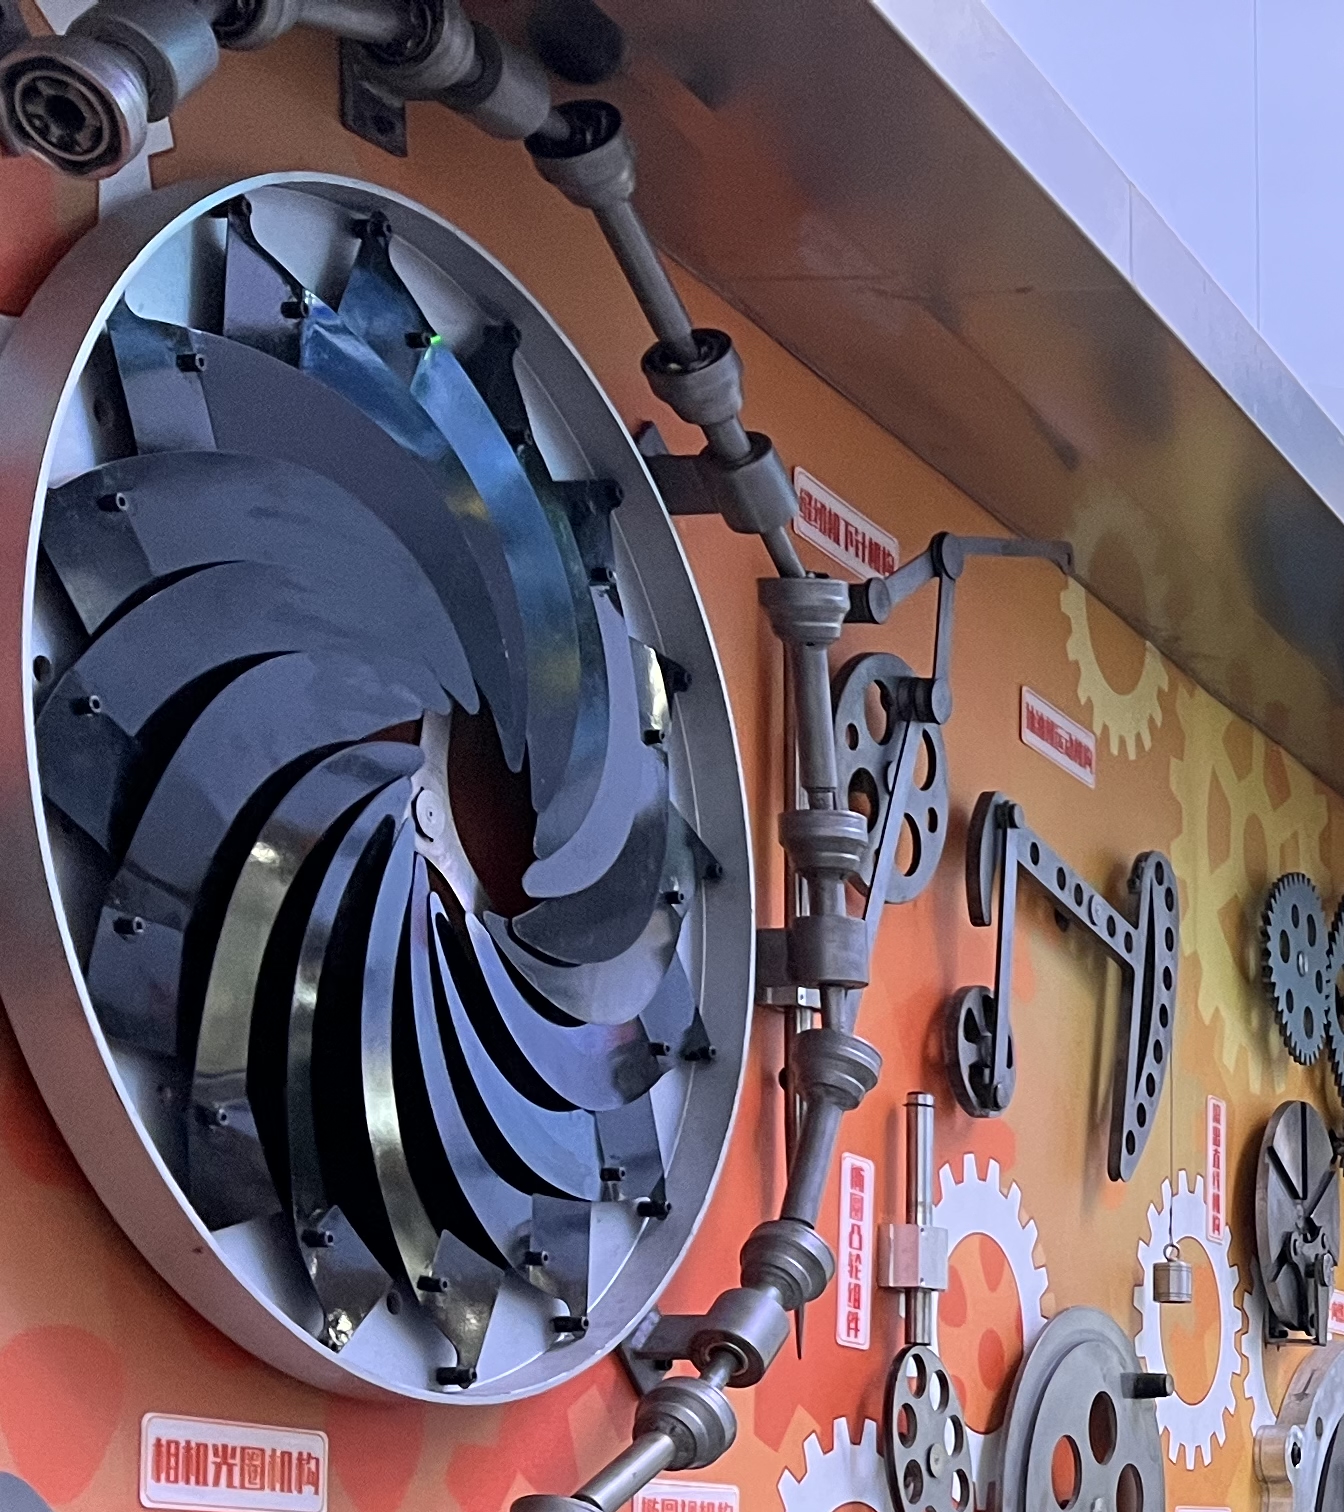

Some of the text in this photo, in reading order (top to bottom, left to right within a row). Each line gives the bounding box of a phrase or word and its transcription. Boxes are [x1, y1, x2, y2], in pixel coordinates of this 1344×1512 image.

[152, 1437, 320, 1495] 相机光圈机构
